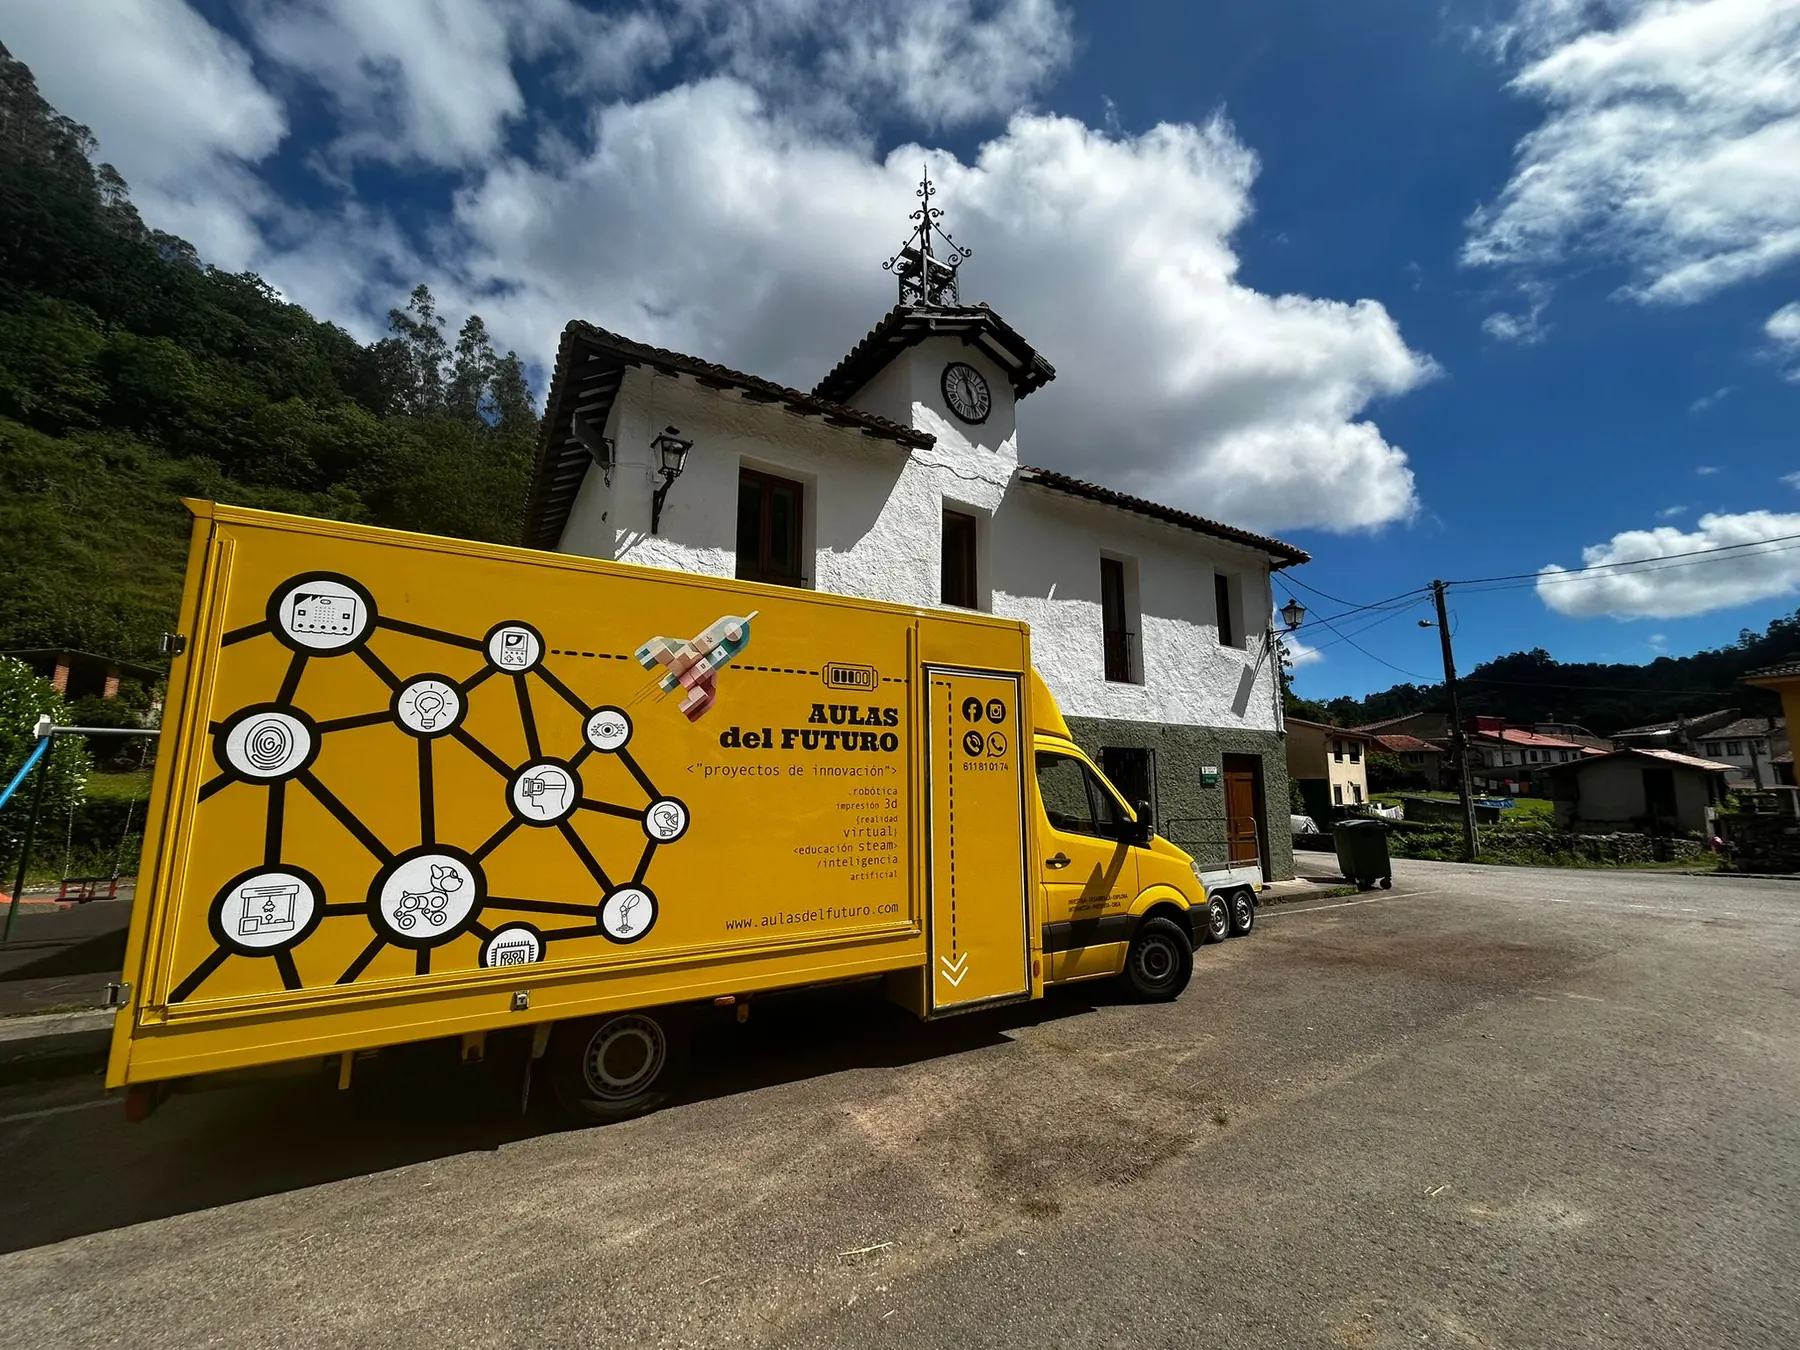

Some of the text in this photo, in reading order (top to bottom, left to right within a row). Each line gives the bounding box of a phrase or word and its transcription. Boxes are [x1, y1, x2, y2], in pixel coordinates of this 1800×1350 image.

[808, 703, 899, 727] AULAS
[719, 727, 899, 752] del FUTURO
[788, 764, 804, 776] de
[836, 798, 898, 811] impresión 3d
[850, 870, 898, 880] artificial
[725, 902, 899, 931] www.aulasdelfuturo.com
